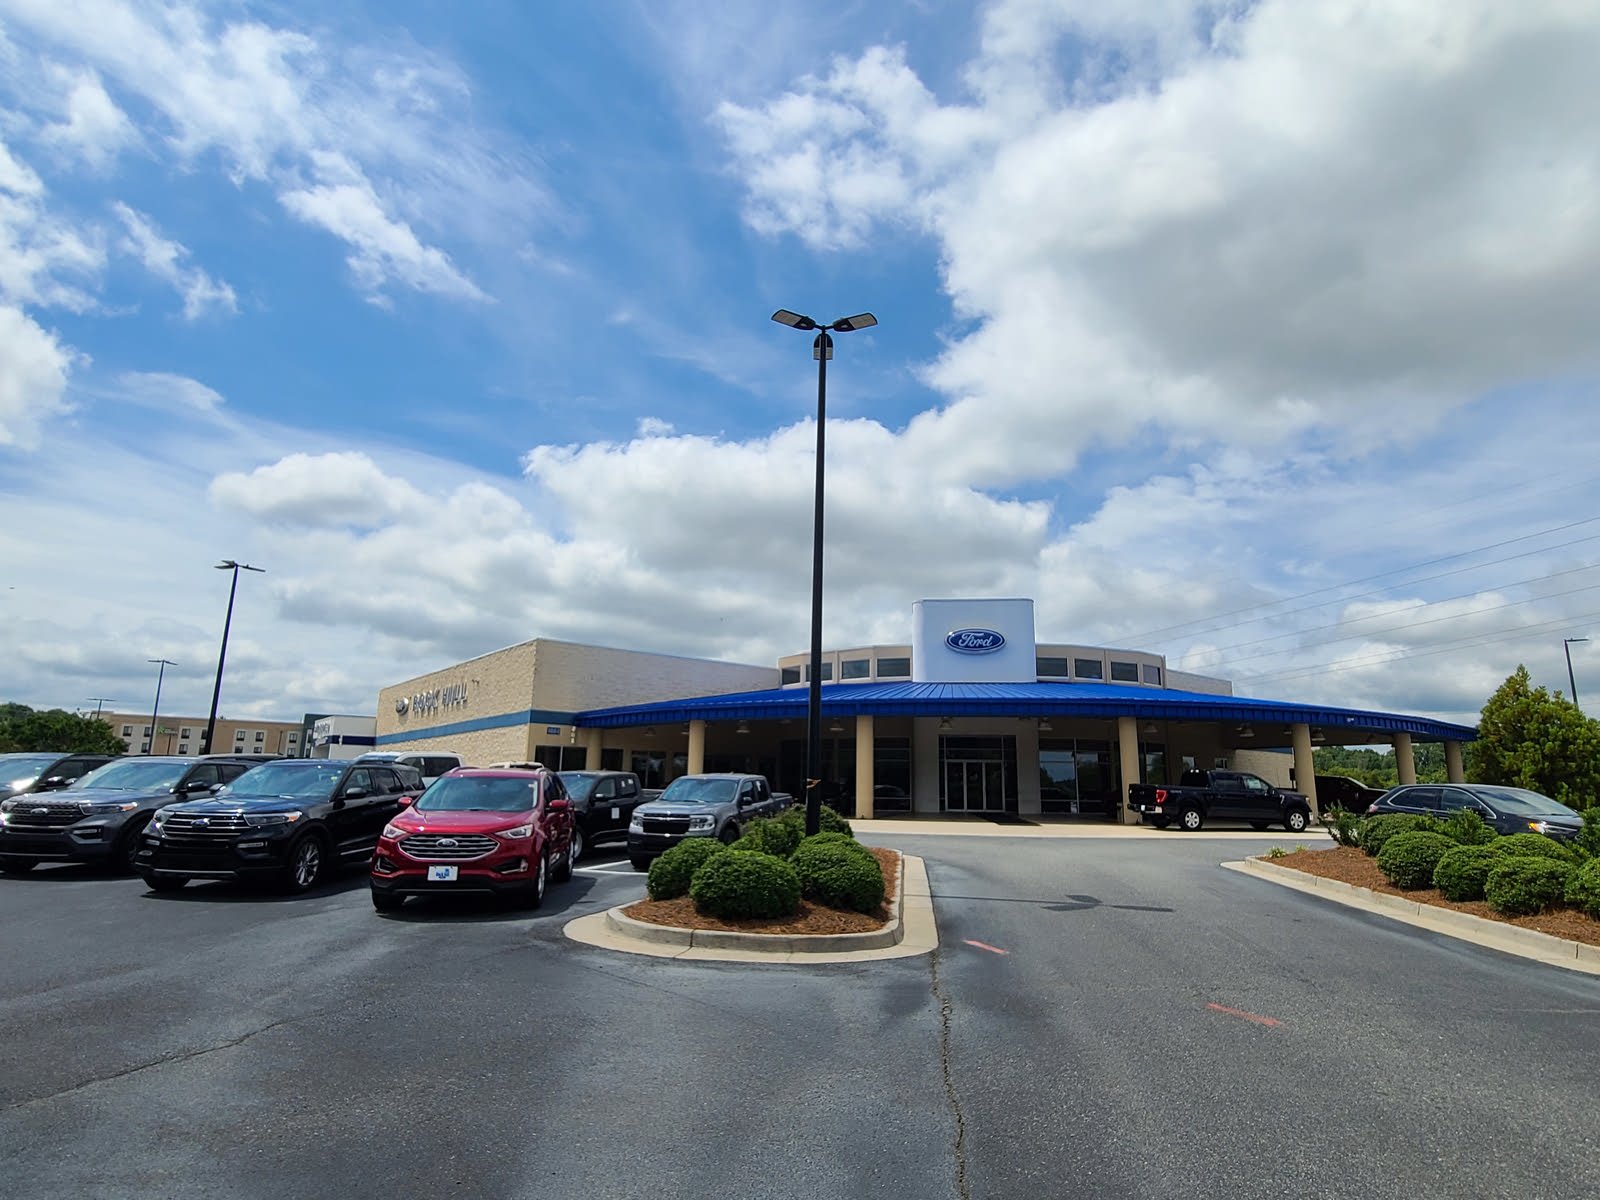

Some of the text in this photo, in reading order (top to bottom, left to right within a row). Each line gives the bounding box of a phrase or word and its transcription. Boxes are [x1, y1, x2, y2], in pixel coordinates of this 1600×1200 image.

[958, 632, 993, 647] Ford
[412, 688, 440, 712] ROCK
[442, 682, 467, 705] HILL
